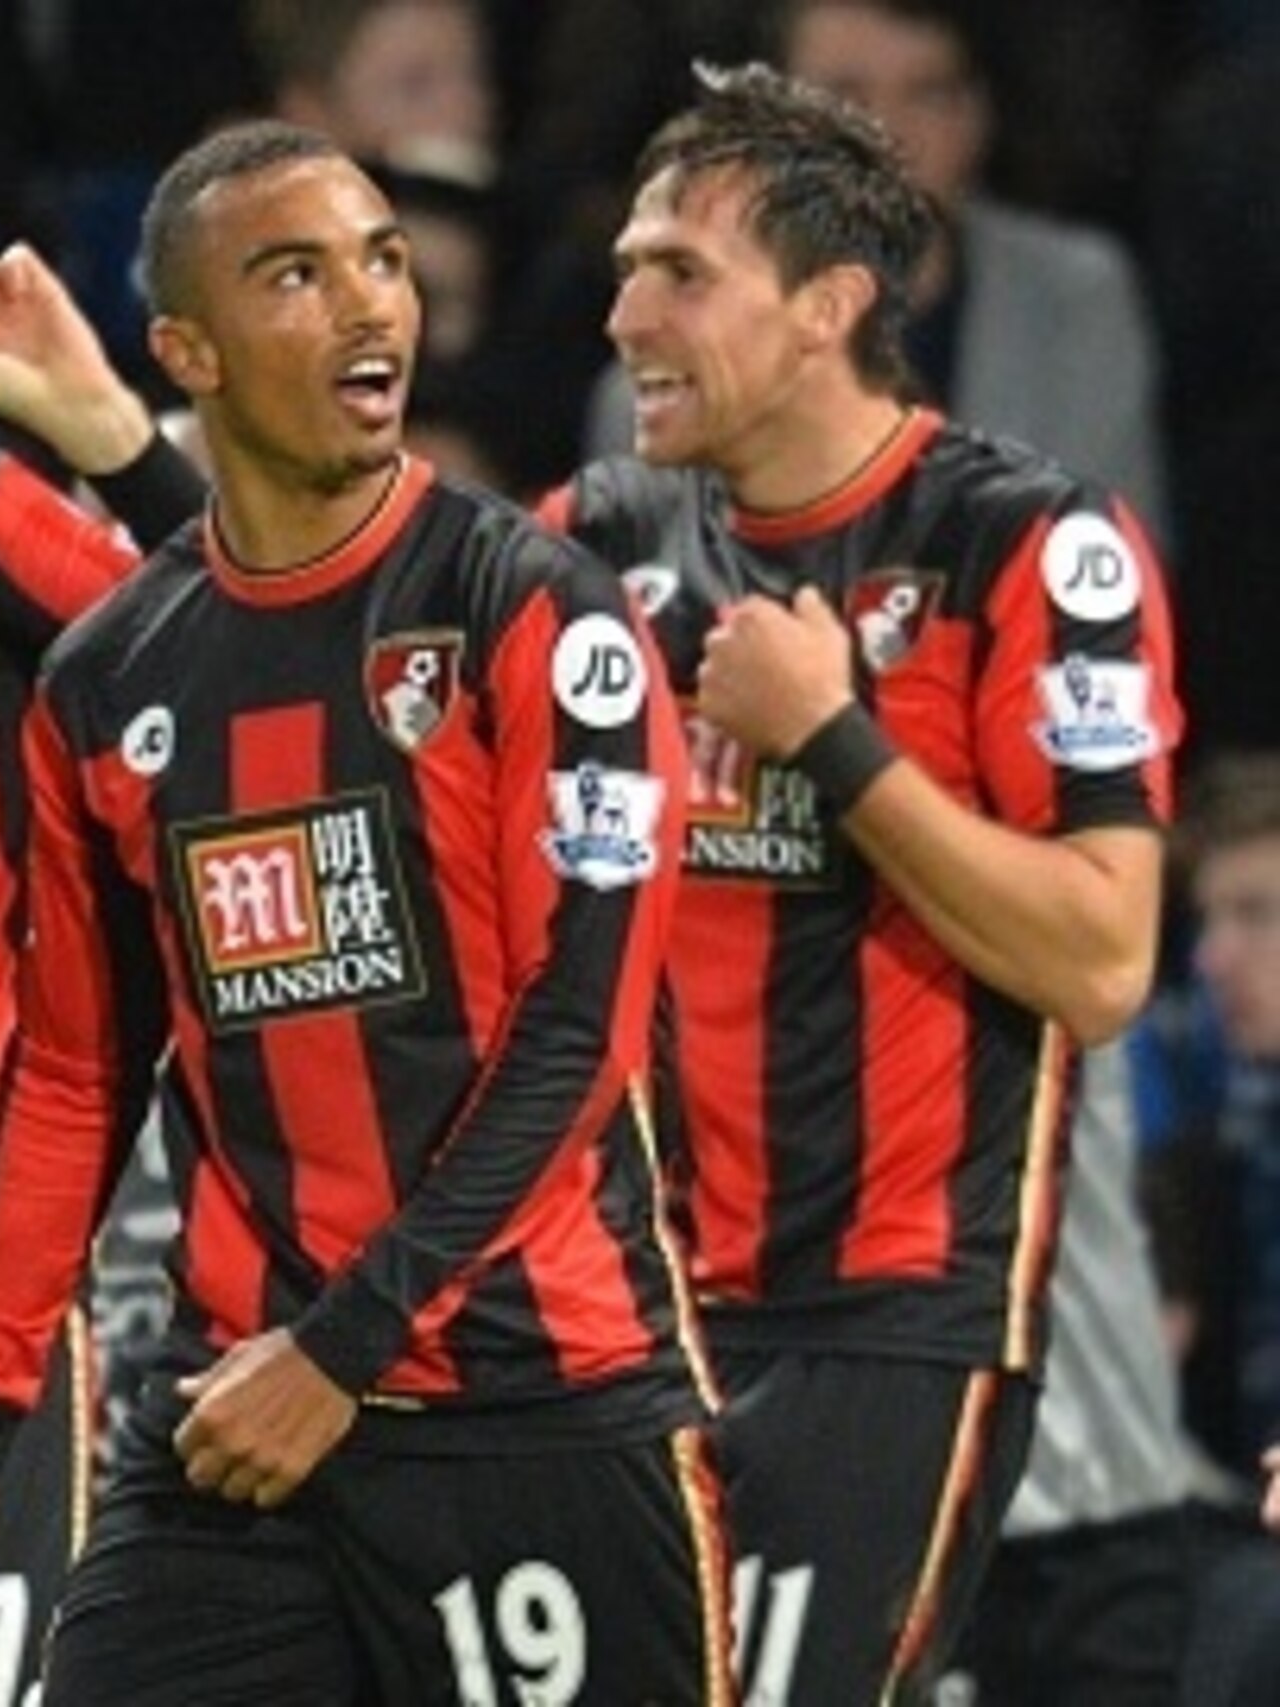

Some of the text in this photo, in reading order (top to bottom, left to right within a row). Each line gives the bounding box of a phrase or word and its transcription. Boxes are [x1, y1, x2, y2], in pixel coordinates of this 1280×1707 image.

[1063, 543, 1124, 591] JD
[571, 644, 635, 697] JD
[679, 822, 827, 874] NSION
[213, 946, 403, 1018] MANSION
[431, 1559, 587, 1707] 19
